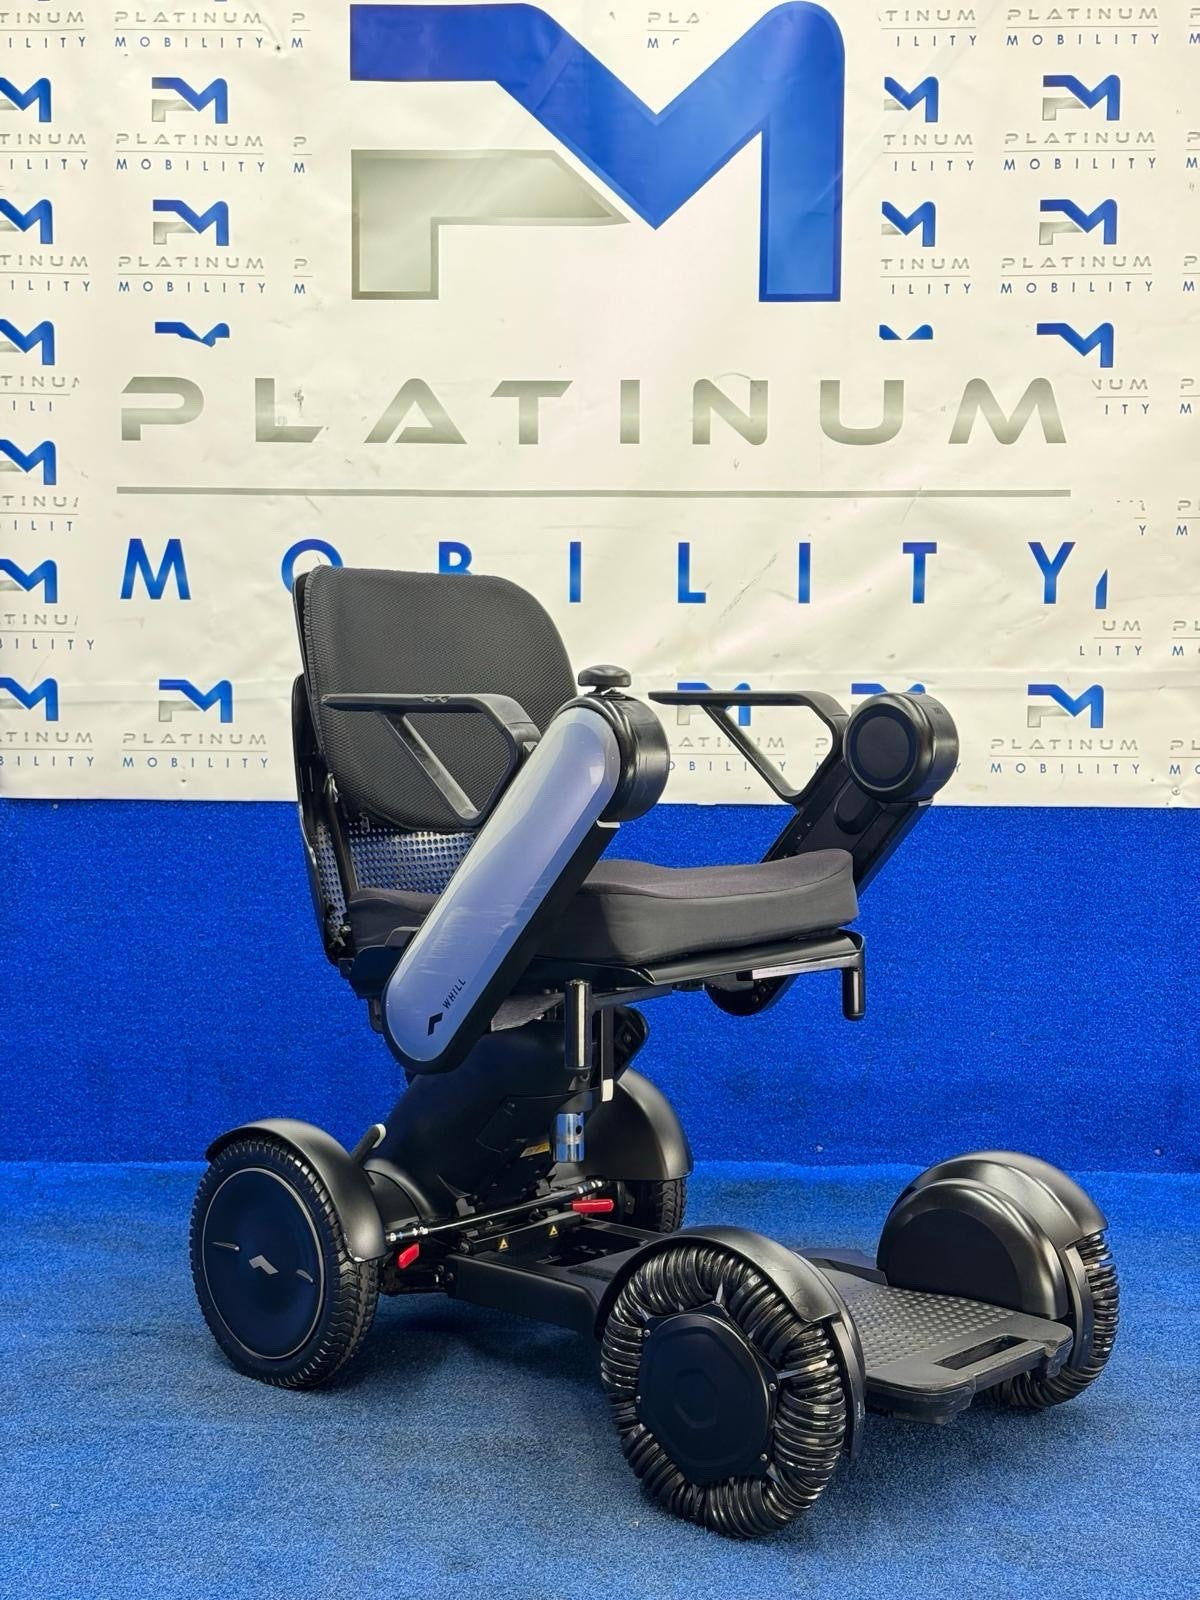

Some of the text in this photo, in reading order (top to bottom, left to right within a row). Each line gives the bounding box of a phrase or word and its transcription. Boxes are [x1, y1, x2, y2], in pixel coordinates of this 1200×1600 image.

[115, 11, 262, 25] PLATINUM
[879, 9, 975, 21] TINUM
[1008, 8, 1157, 20] PLATINUM
[115, 36, 263, 48] MOBILITY
[1007, 34, 1159, 46] MOBILITY
[116, 133, 263, 147] PLATINUM
[1005, 132, 1154, 144] PLATINUM
[351, 2, 845, 301] PM
[116, 158, 264, 172] MOBILITY
[1004, 157, 1156, 171] MOBILITY
[118, 256, 264, 269] PLATINUM
[1002, 256, 1151, 268] PLATINUM
[119, 281, 265, 293] MOBILITY
[1001, 281, 1152, 294] MOBILITY
[121, 377, 1067, 446] PLATINUM
[1105, 404, 1149, 415] ITY
[4, 614, 78, 625] TINU
[123, 733, 266, 744] PLATINUM
[991, 739, 1138, 750] PLATINUM
[123, 757, 268, 768] MOBILITY
[991, 763, 1139, 774] MOBILITY
[442, 978, 466, 1009] WHILL
